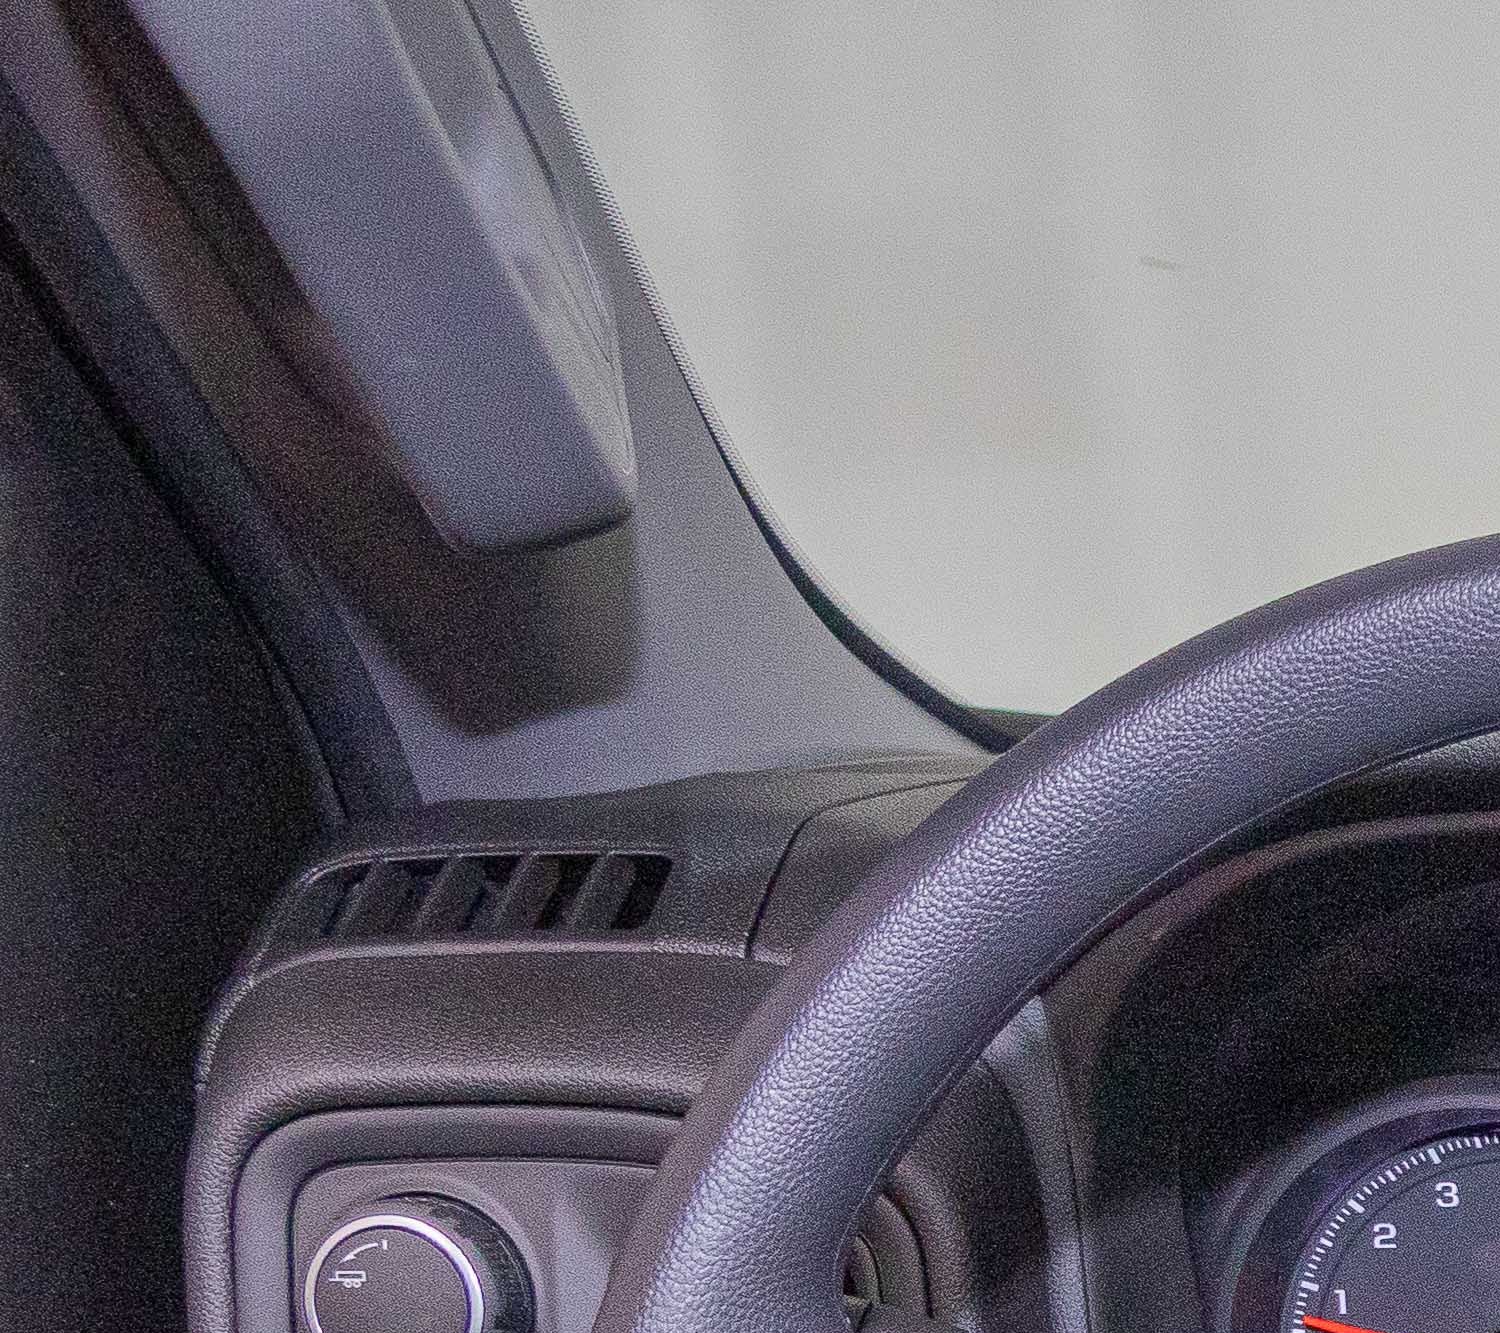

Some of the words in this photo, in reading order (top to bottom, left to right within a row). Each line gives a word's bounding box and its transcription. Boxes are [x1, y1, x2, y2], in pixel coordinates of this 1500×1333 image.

[1434, 1181, 1460, 1207] 3
[1373, 1224, 1398, 1249] 2
[1334, 1289, 1348, 1315] 1
